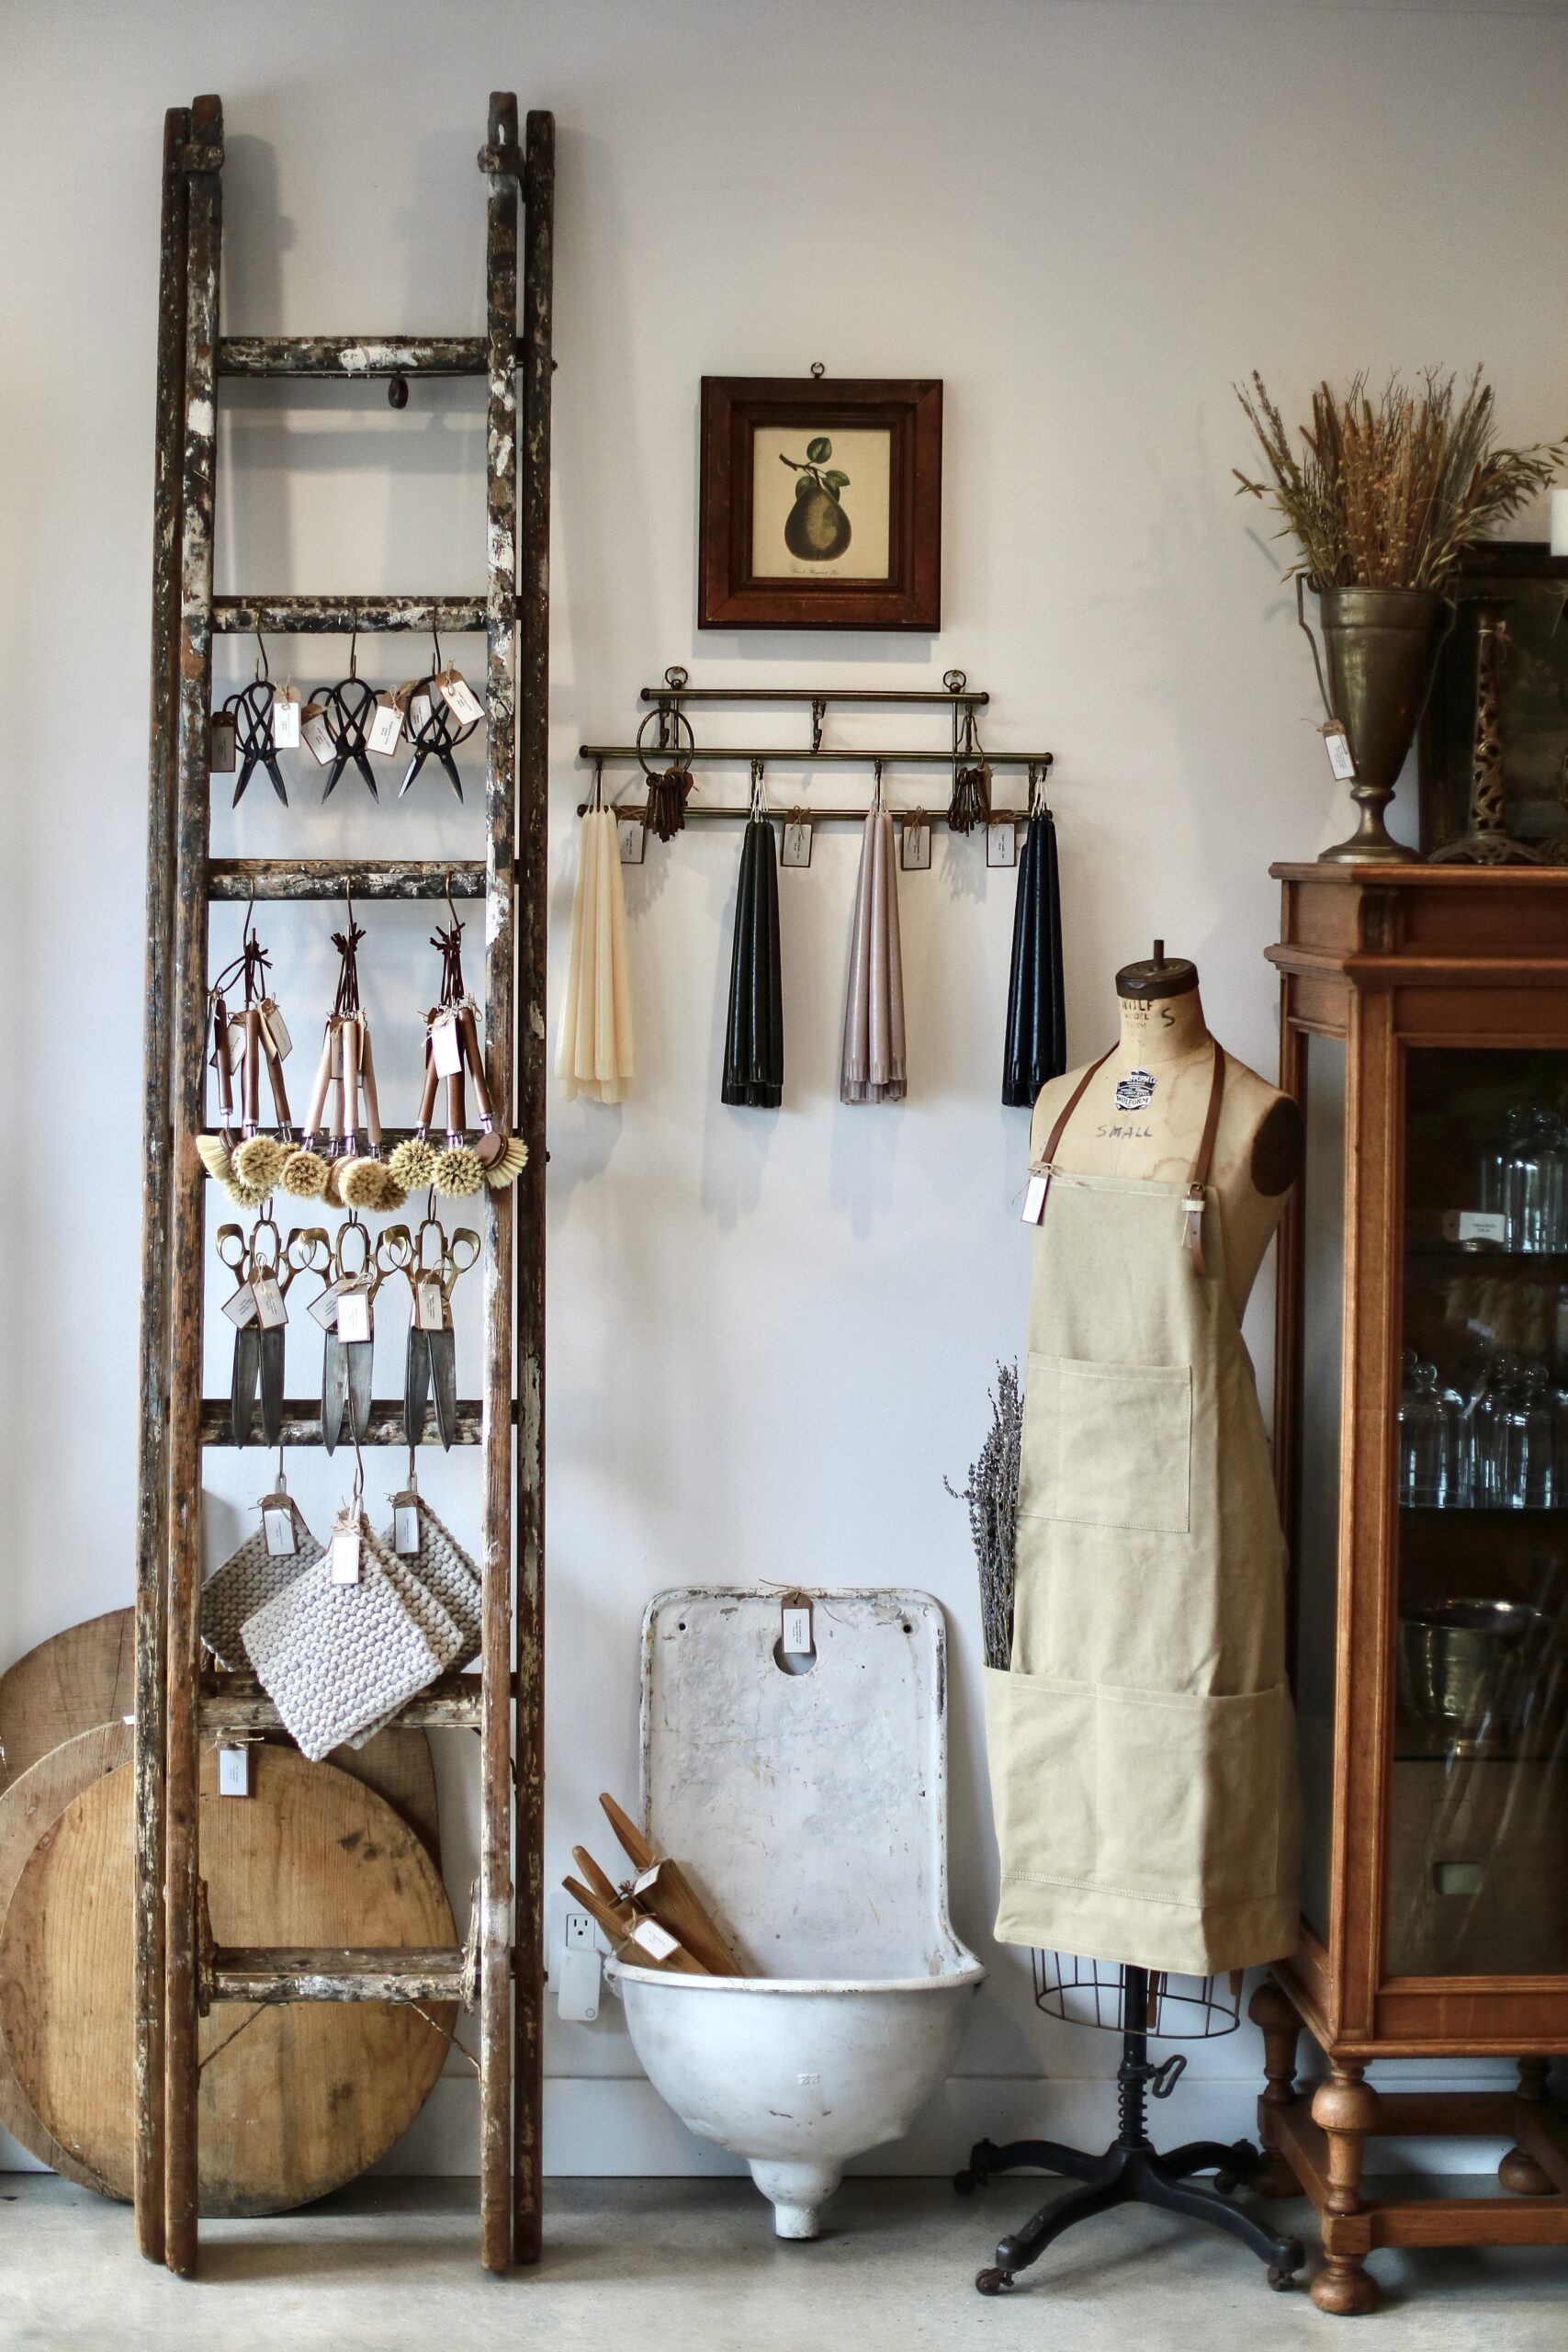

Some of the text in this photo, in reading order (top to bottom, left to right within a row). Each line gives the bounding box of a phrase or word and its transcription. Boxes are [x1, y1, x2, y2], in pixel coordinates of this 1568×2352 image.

[1161, 1007, 1175, 1028] S
[1116, 1095, 1149, 1106] WOLFORM
[1096, 1125, 1153, 1139] SMALL
